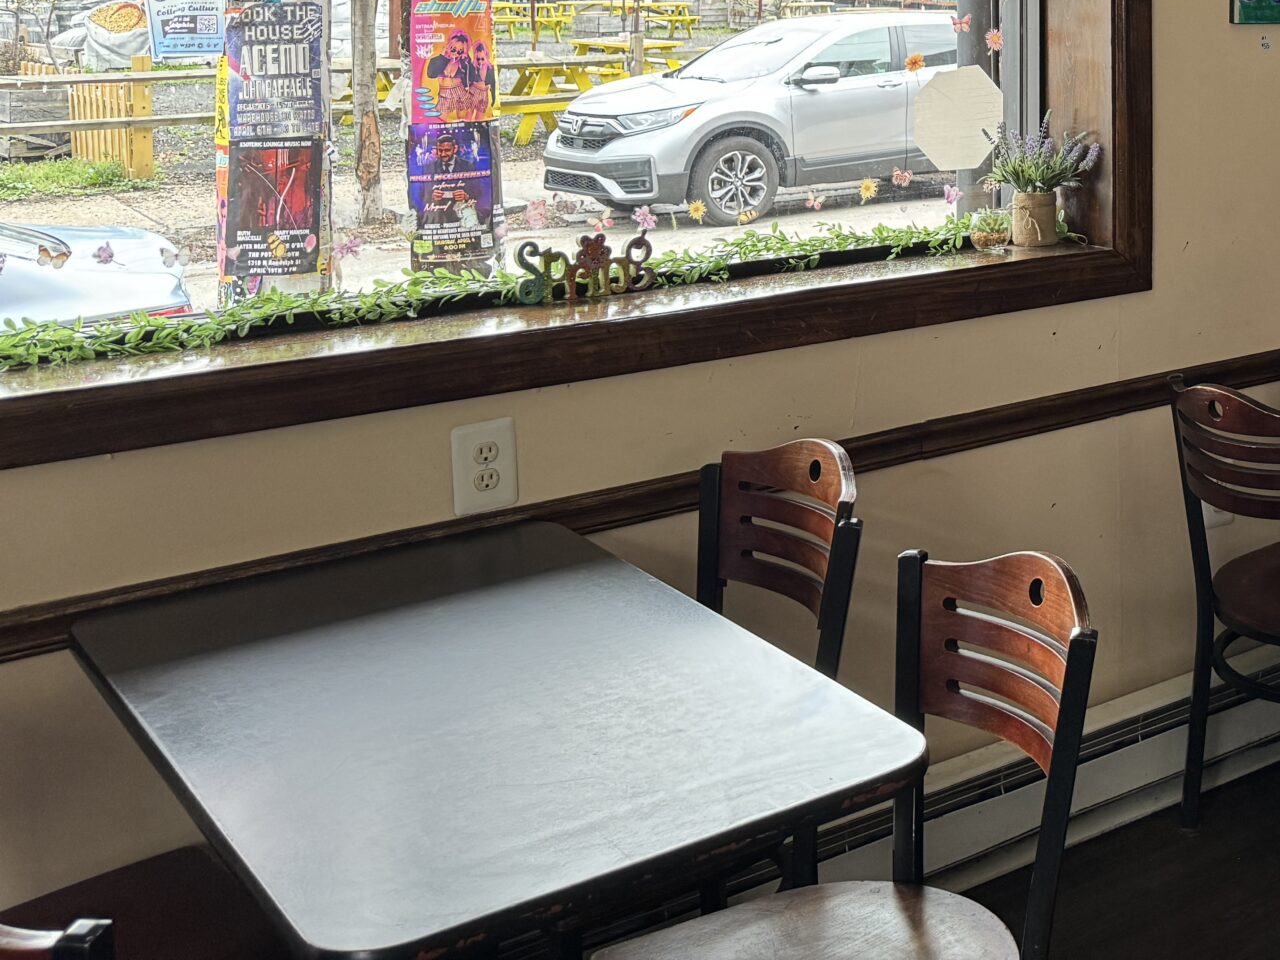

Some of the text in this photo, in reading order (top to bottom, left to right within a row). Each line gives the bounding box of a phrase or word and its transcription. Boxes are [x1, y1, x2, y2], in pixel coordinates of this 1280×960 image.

[240, 5, 318, 22] OOK THE
[245, 24, 304, 41] HOUSE
[239, 43, 310, 76] ACEMO
